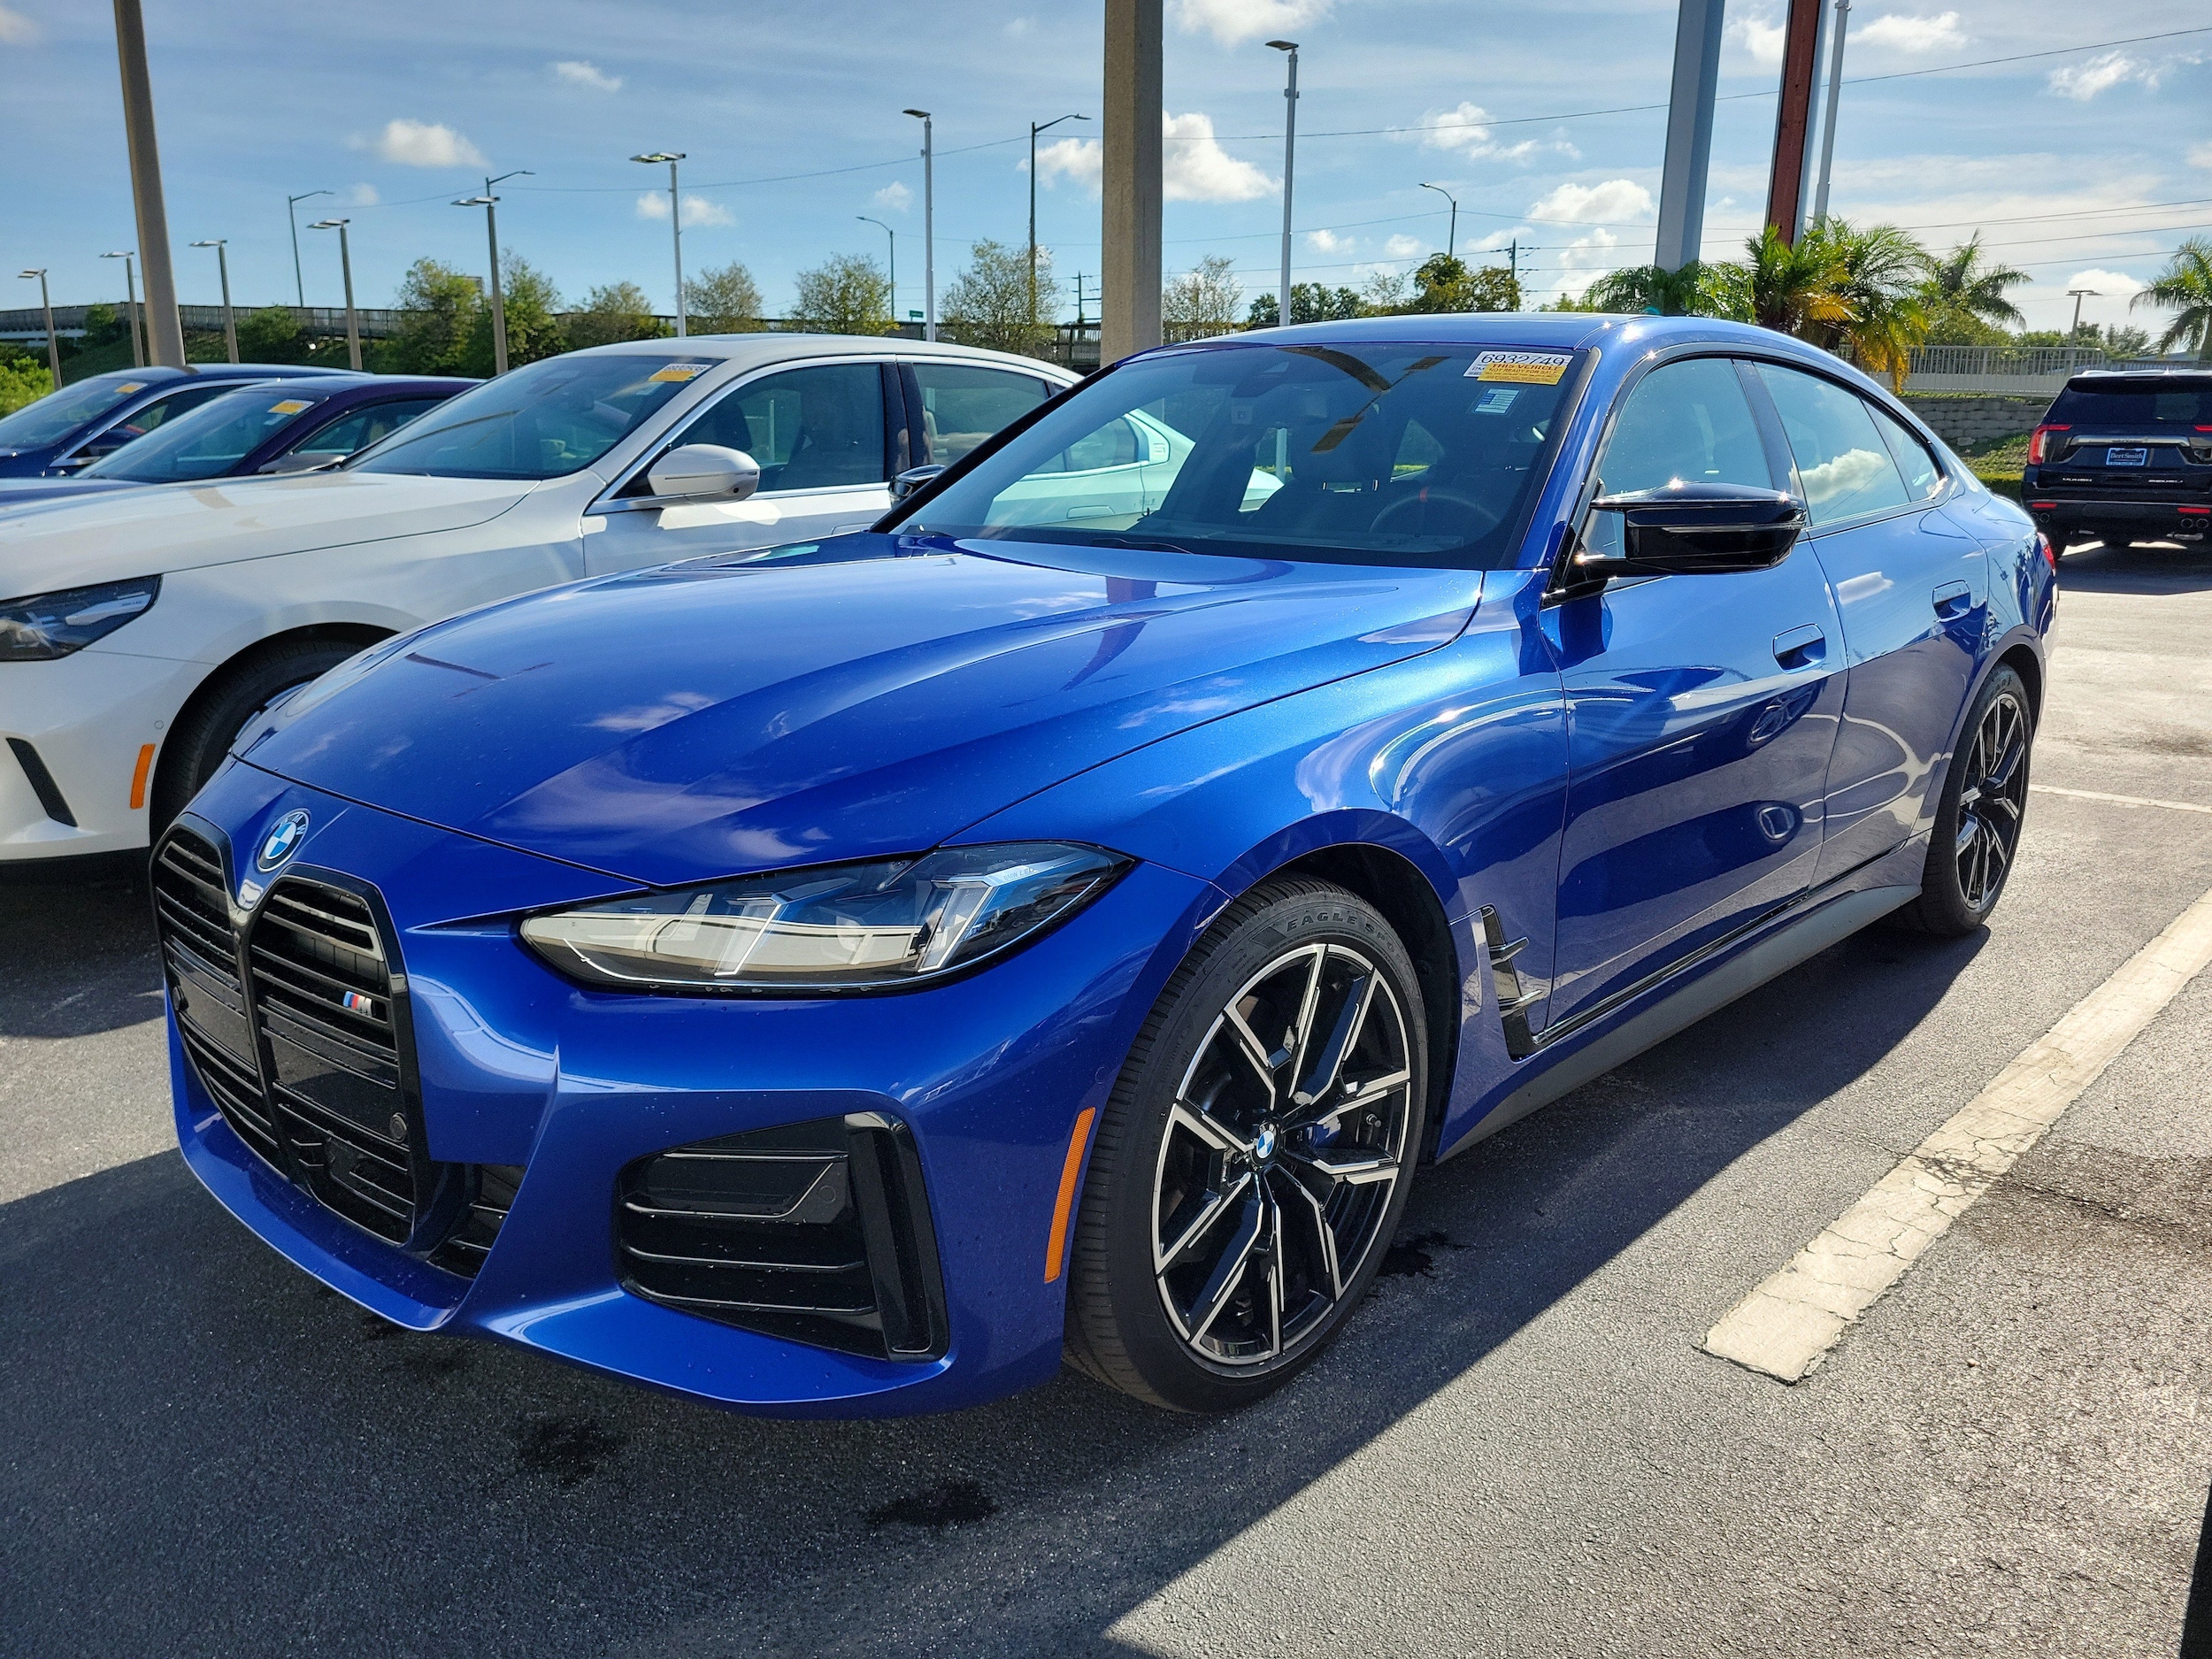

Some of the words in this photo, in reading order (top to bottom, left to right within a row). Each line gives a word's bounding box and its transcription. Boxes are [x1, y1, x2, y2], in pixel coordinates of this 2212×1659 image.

[1481, 354, 1565, 366] 6932749
[1003, 872, 1018, 881] BMW
[1019, 866, 1035, 876] LED
[1286, 912, 1358, 933] EAGLE
